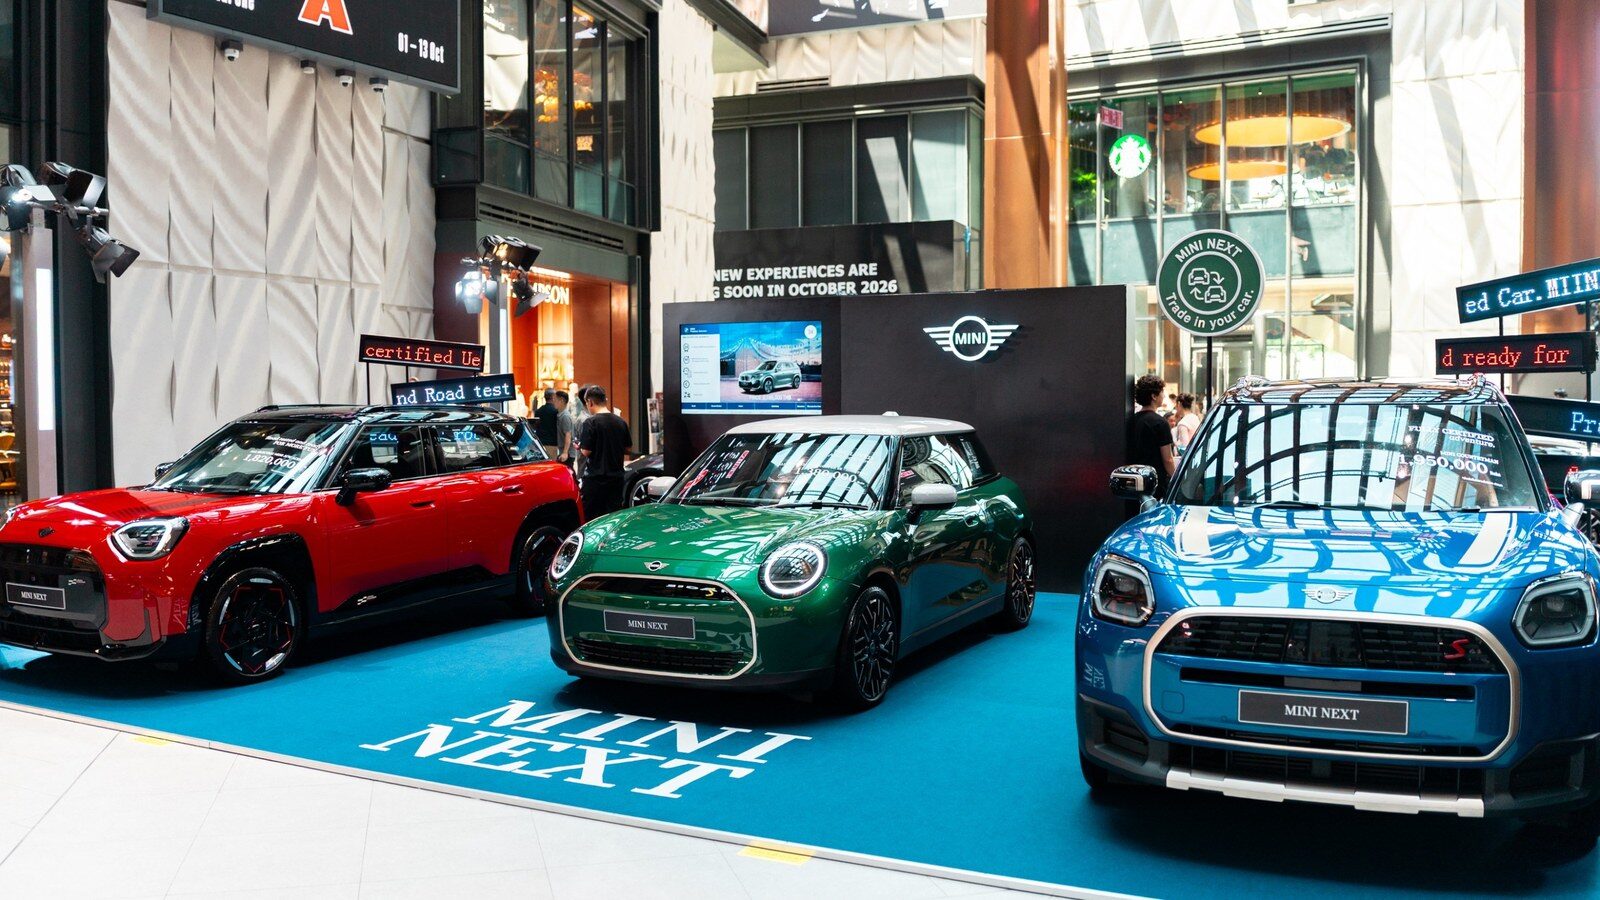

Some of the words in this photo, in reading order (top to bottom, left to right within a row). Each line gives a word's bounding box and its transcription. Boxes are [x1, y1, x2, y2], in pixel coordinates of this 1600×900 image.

[418, 38, 429, 59] 13
[429, 41, 445, 64] Oct
[1174, 239, 1204, 263] MINI
[1206, 238, 1243, 258] NEXT
[713, 269, 743, 282] NEW
[746, 264, 845, 281] EXPERIENCES
[848, 262, 878, 277] ARE
[723, 284, 764, 299] SOON
[767, 284, 785, 298] IN
[788, 281, 857, 296] OCTOBER
[860, 280, 898, 294] 2026
[1165, 292, 1192, 323] Trade
[1193, 316, 1206, 328] in
[1209, 310, 1237, 331] your
[1237, 289, 1255, 313] car.
[1465, 292, 1490, 314] ed
[954, 332, 986, 345] MINI
[365, 345, 453, 364] certified
[461, 350, 482, 367] Ue
[1442, 348, 1453, 367] d
[1462, 346, 1522, 368] ready
[1533, 344, 1570, 364] for
[396, 389, 417, 405] nd
[425, 384, 466, 403] Road
[473, 382, 510, 398] test
[21, 590, 33, 600] MINI
[33, 592, 47, 601] NEXT
[628, 619, 646, 629] MINI
[647, 621, 668, 631] NEXT
[1443, 638, 1469, 660] S
[1284, 704, 1318, 718] MINI
[1320, 707, 1360, 721] NEXT
[452, 699, 813, 764] MINI
[358, 723, 756, 799] NEXT
